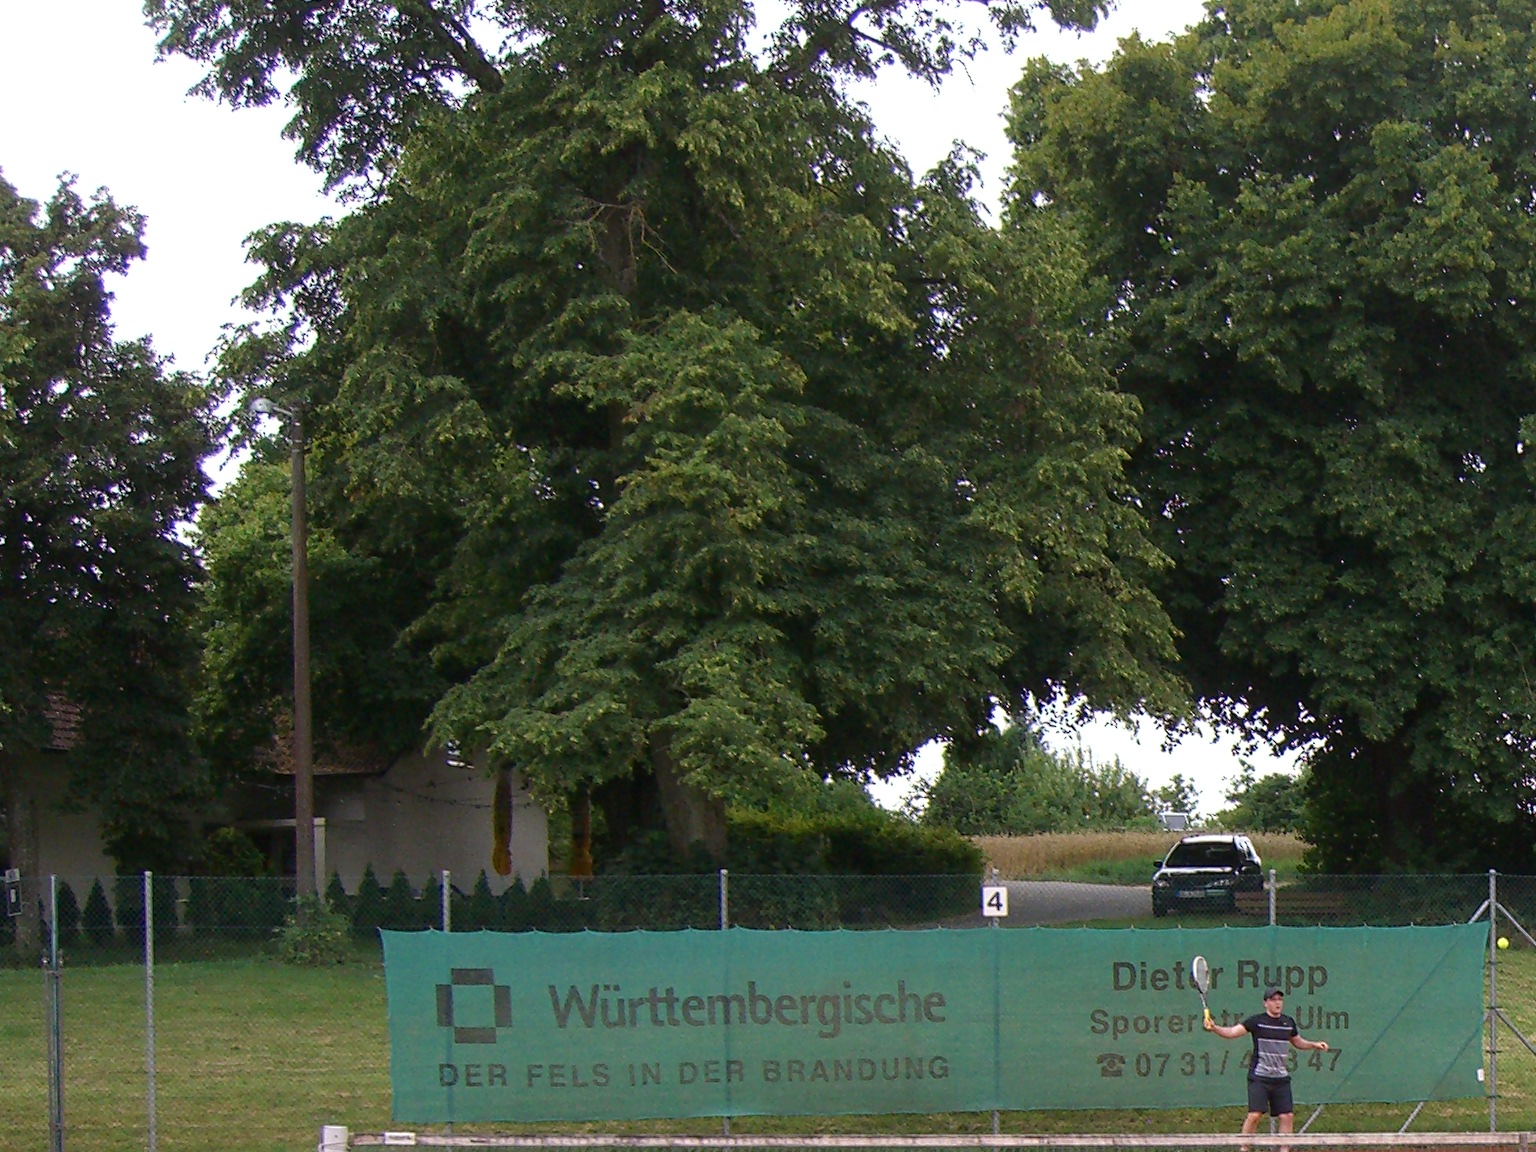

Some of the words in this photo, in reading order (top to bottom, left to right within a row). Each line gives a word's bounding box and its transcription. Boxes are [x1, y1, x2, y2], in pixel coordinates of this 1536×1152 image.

[987, 891, 1003, 911] 4
[1237, 960, 1328, 995] Rupp
[547, 980, 947, 1039] Württembergische
[1296, 1005, 1349, 1030] Ulm
[439, 1062, 508, 1088] DER
[527, 1062, 611, 1088] FELS
[630, 1062, 661, 1087] IN
[679, 1059, 745, 1085] DER
[763, 1055, 950, 1083] BRANDUNG
